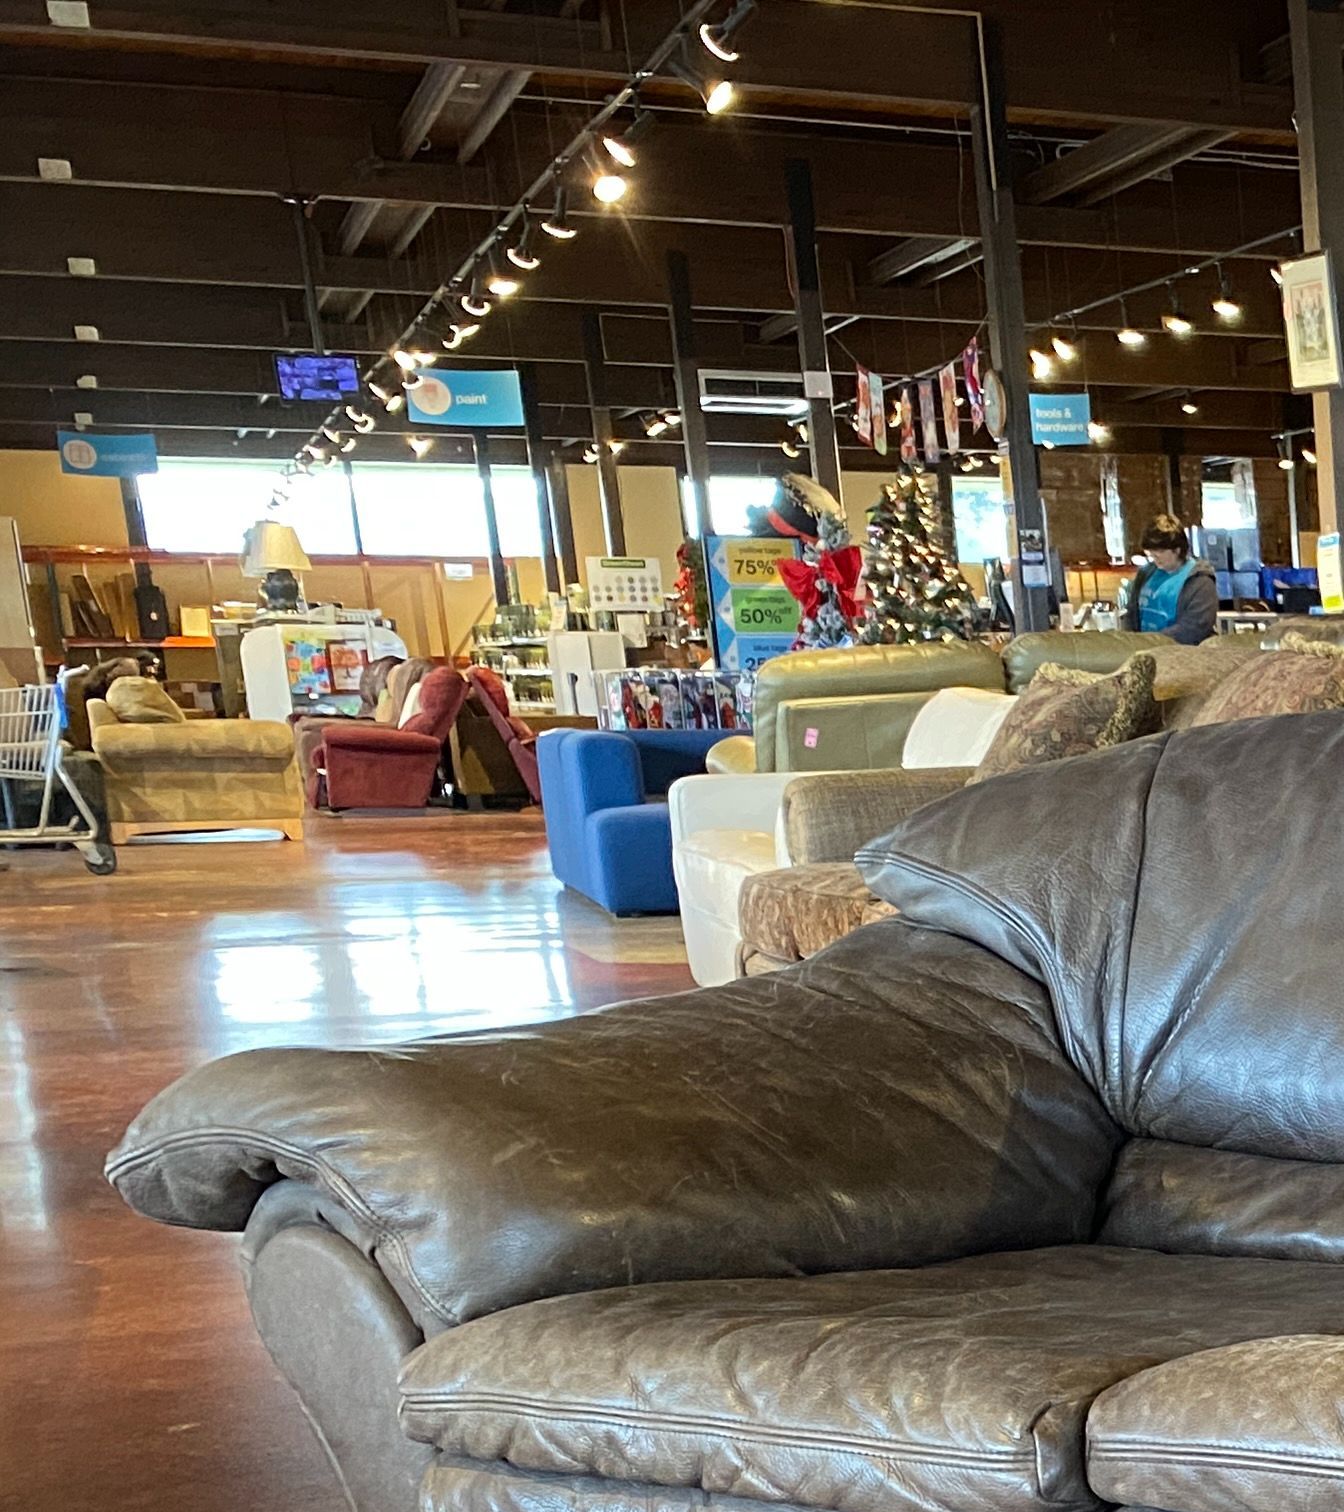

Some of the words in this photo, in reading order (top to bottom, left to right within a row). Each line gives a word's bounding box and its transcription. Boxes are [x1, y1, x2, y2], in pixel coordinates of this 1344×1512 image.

[455, 392, 488, 405] paint
[1035, 408, 1062, 418] tools
[1064, 407, 1072, 418] &
[1035, 422, 1084, 432] hardware
[734, 559, 775, 575] 75%
[740, 608, 782, 624] 50%
